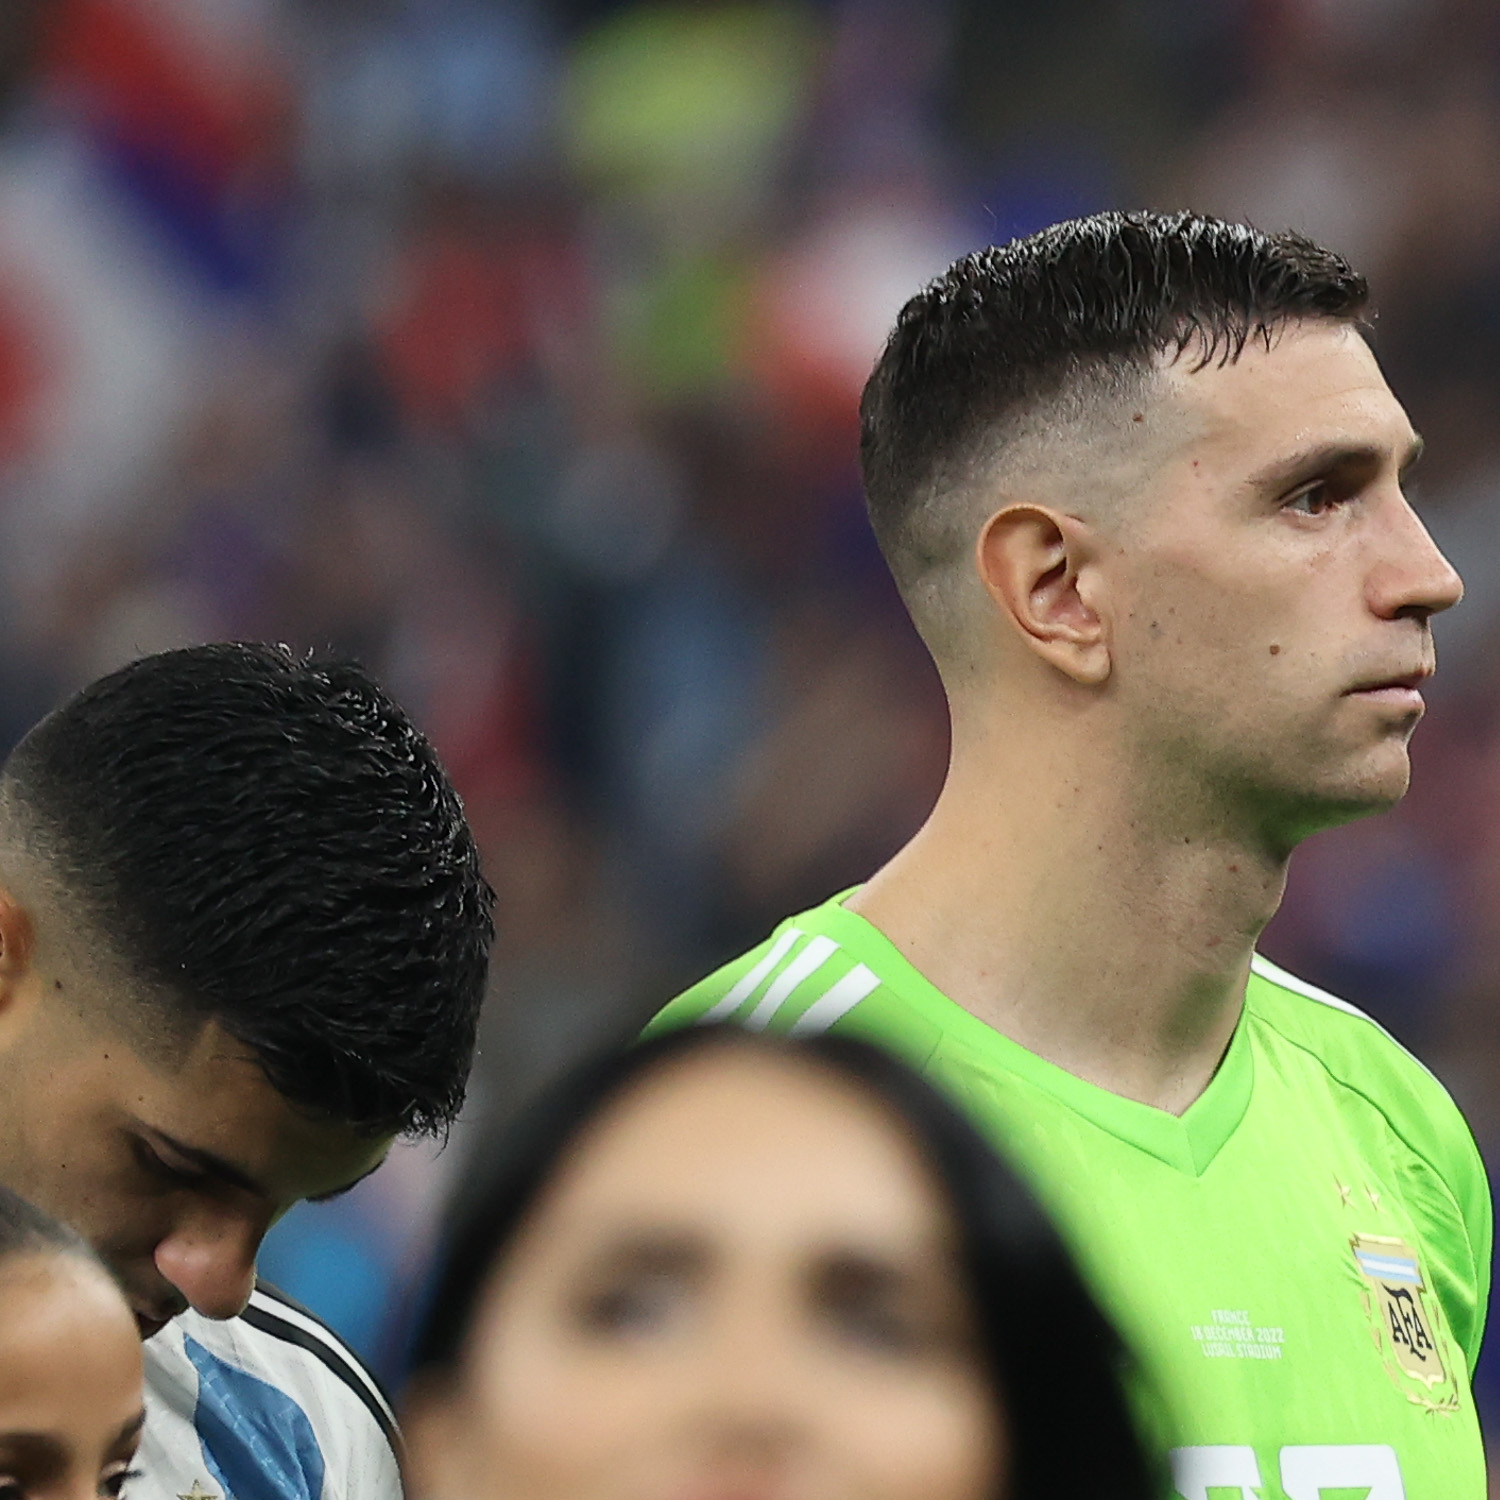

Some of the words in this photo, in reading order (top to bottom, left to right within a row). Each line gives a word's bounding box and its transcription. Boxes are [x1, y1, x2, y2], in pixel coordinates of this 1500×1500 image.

[1211, 1309, 1250, 1325] FRANCE
[1381, 1281, 1432, 1362] AFA
[1203, 1326, 1254, 1342] DECEMBER
[1255, 1327, 1285, 1344] 2022
[1236, 1344, 1283, 1360] STADIUM
